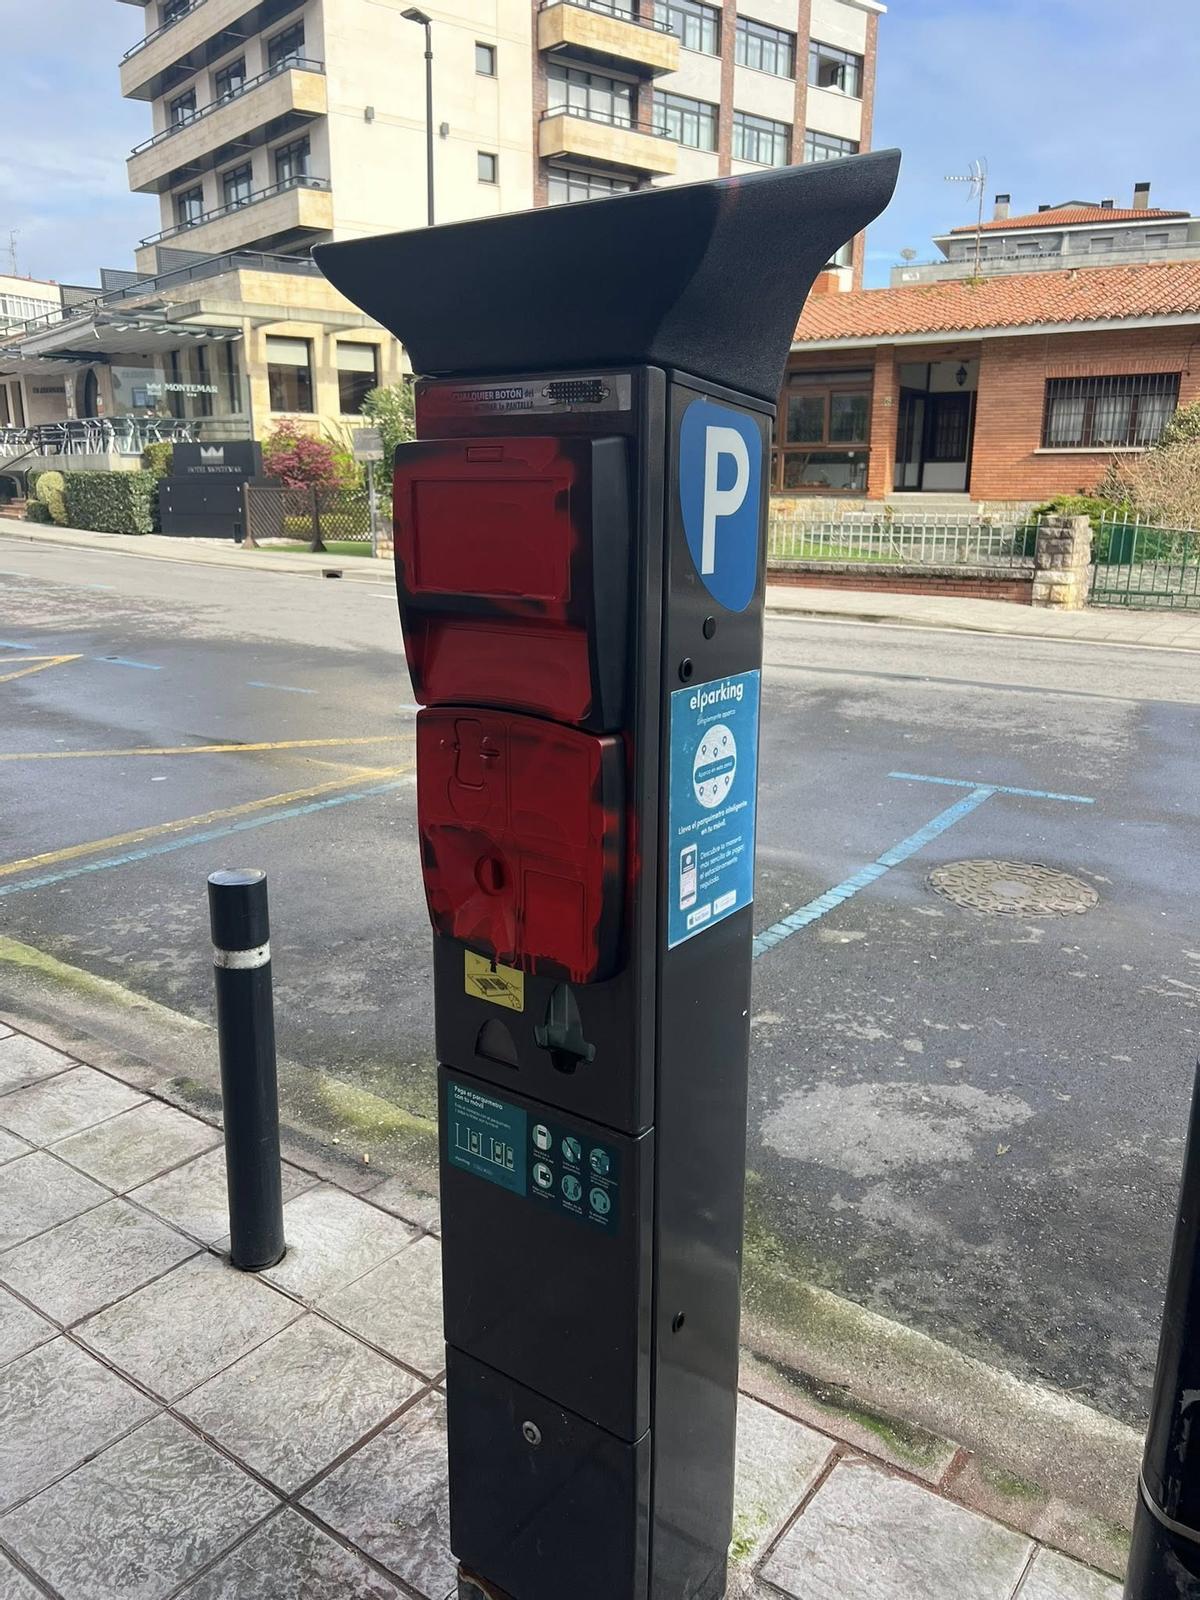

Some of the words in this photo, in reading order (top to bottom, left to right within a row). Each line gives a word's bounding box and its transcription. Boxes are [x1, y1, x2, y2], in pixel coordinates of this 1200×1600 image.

[164, 383, 218, 393] MONTEMAR
[495, 387, 522, 399] BOTÓN
[188, 465, 206, 473] HOTEL
[701, 425, 750, 575] P
[690, 681, 744, 712] elparking
[678, 825, 692, 835] Lleva
